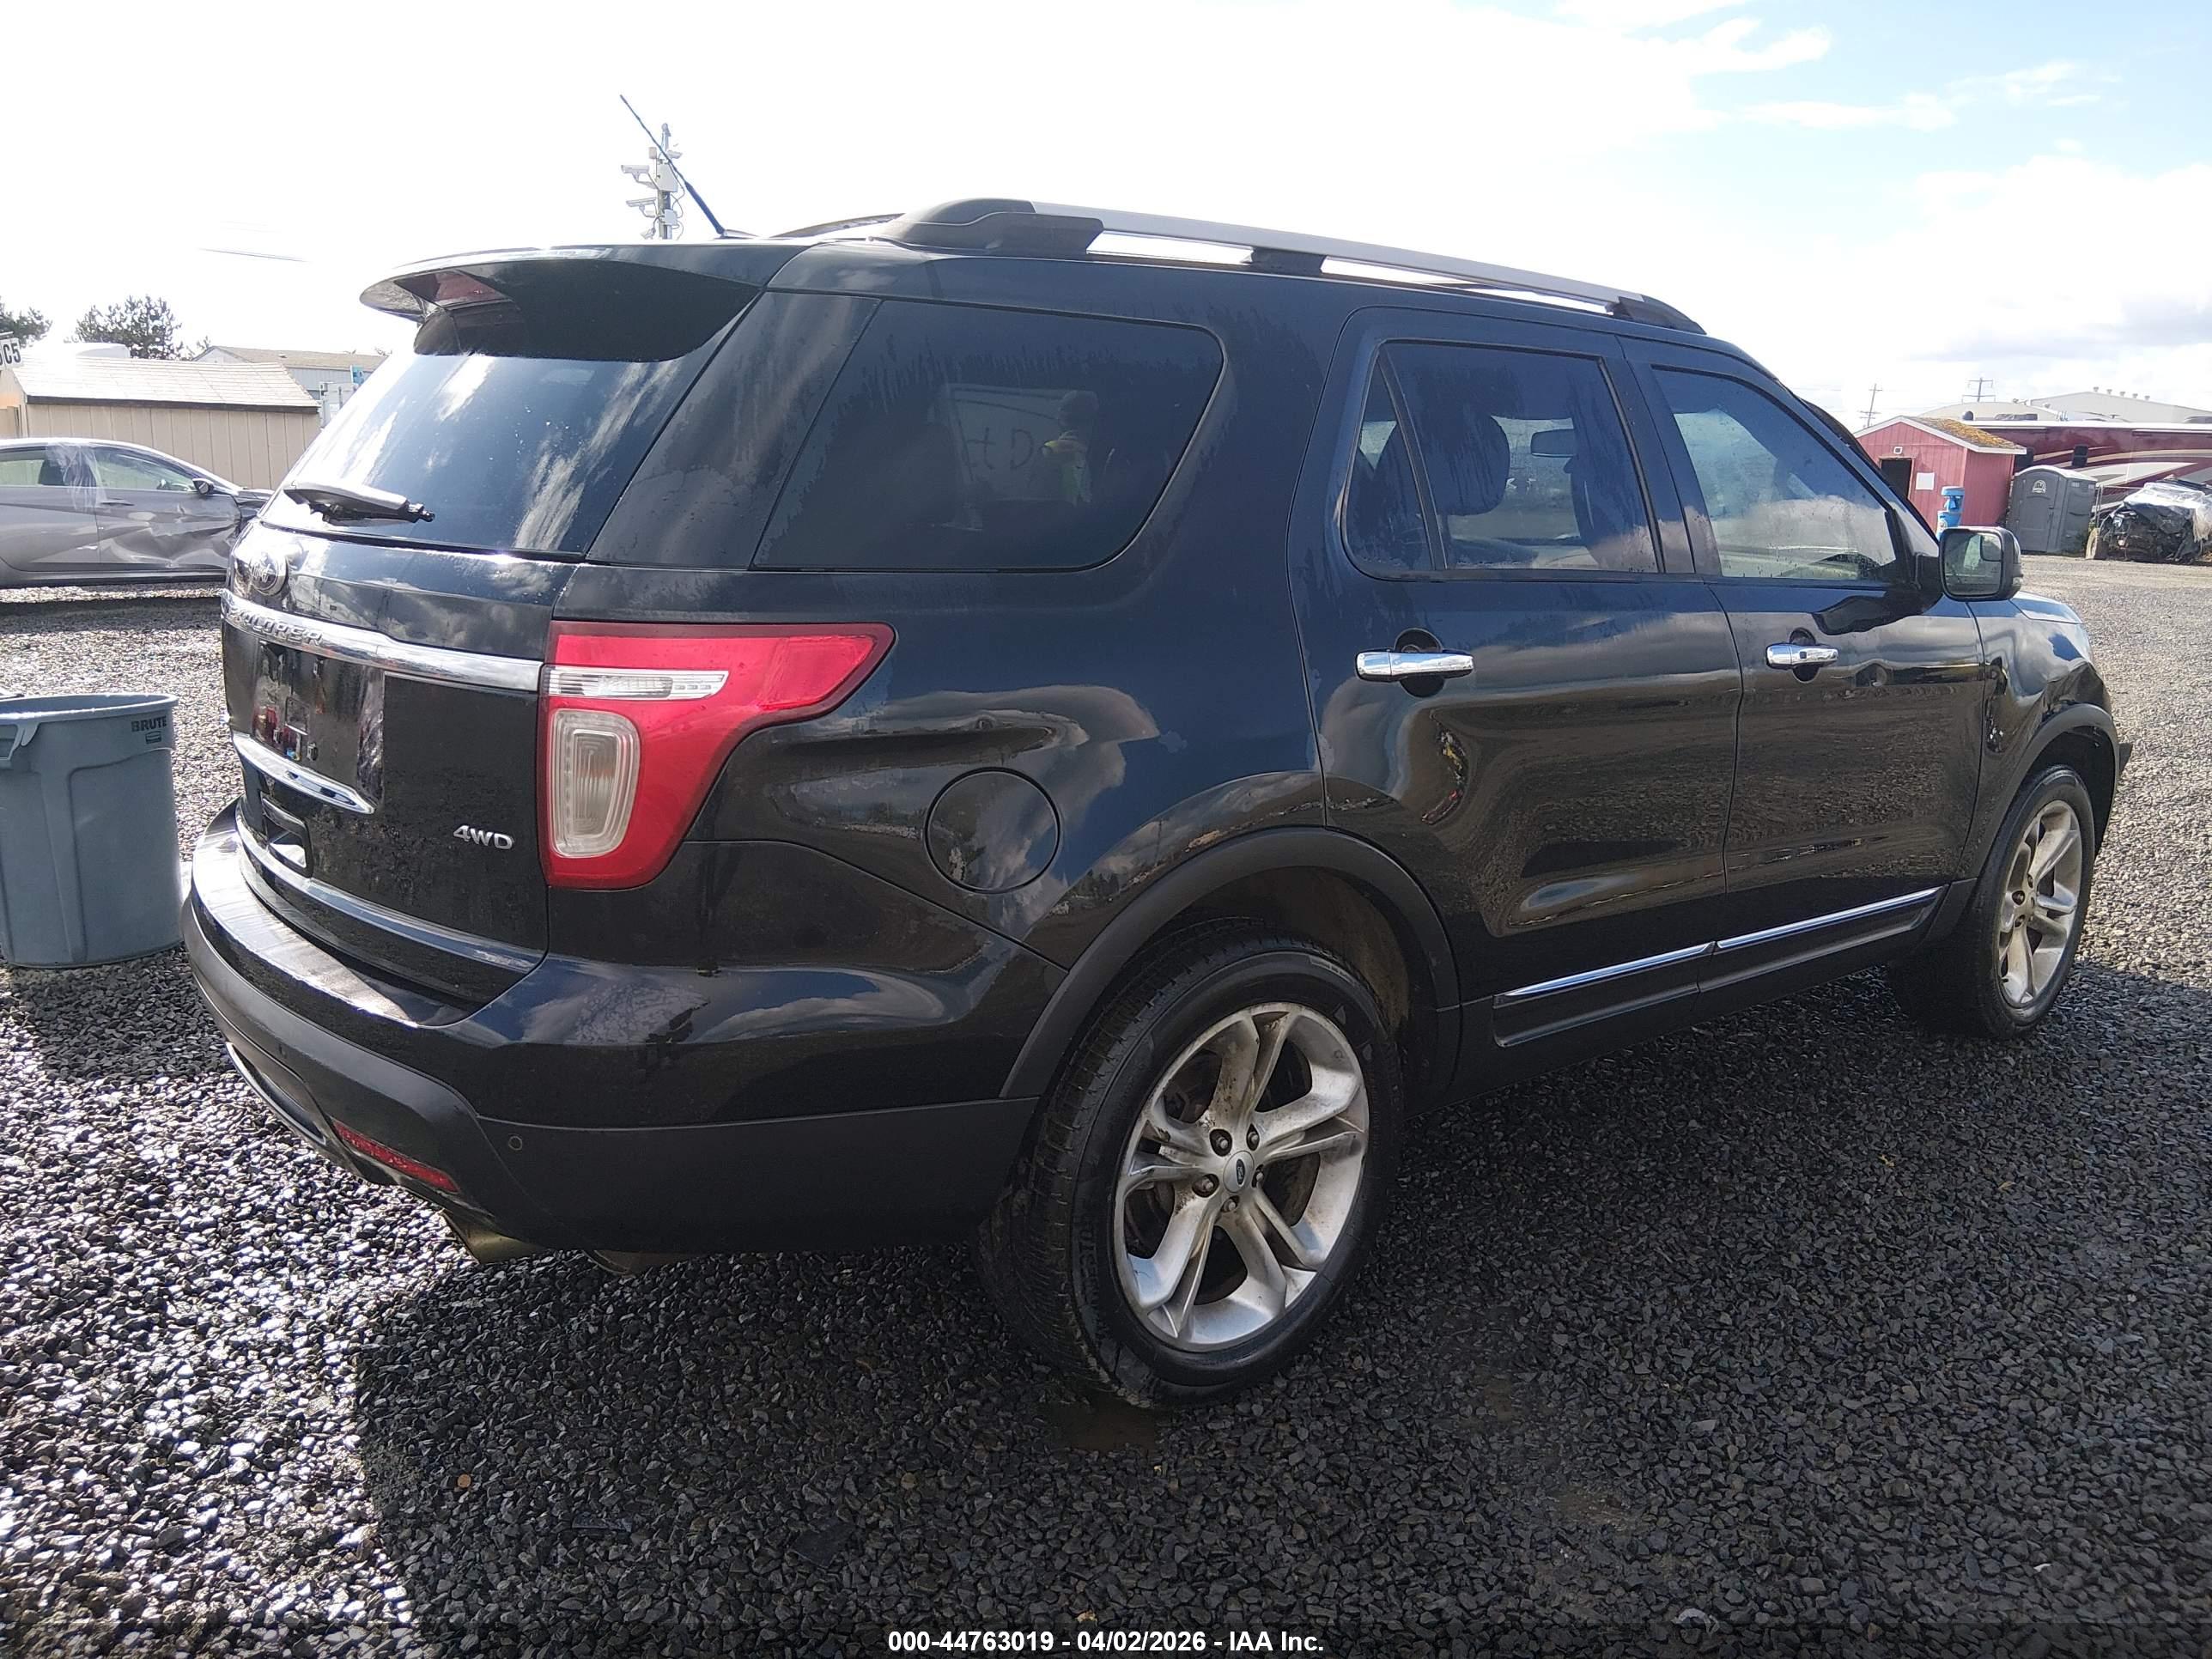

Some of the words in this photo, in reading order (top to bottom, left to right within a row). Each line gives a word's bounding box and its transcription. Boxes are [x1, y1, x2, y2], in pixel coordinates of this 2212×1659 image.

[0, 343, 21, 365] C5
[227, 605, 325, 646] PLORER
[131, 715, 167, 732] BRUTE
[453, 824, 514, 850] 4WD
